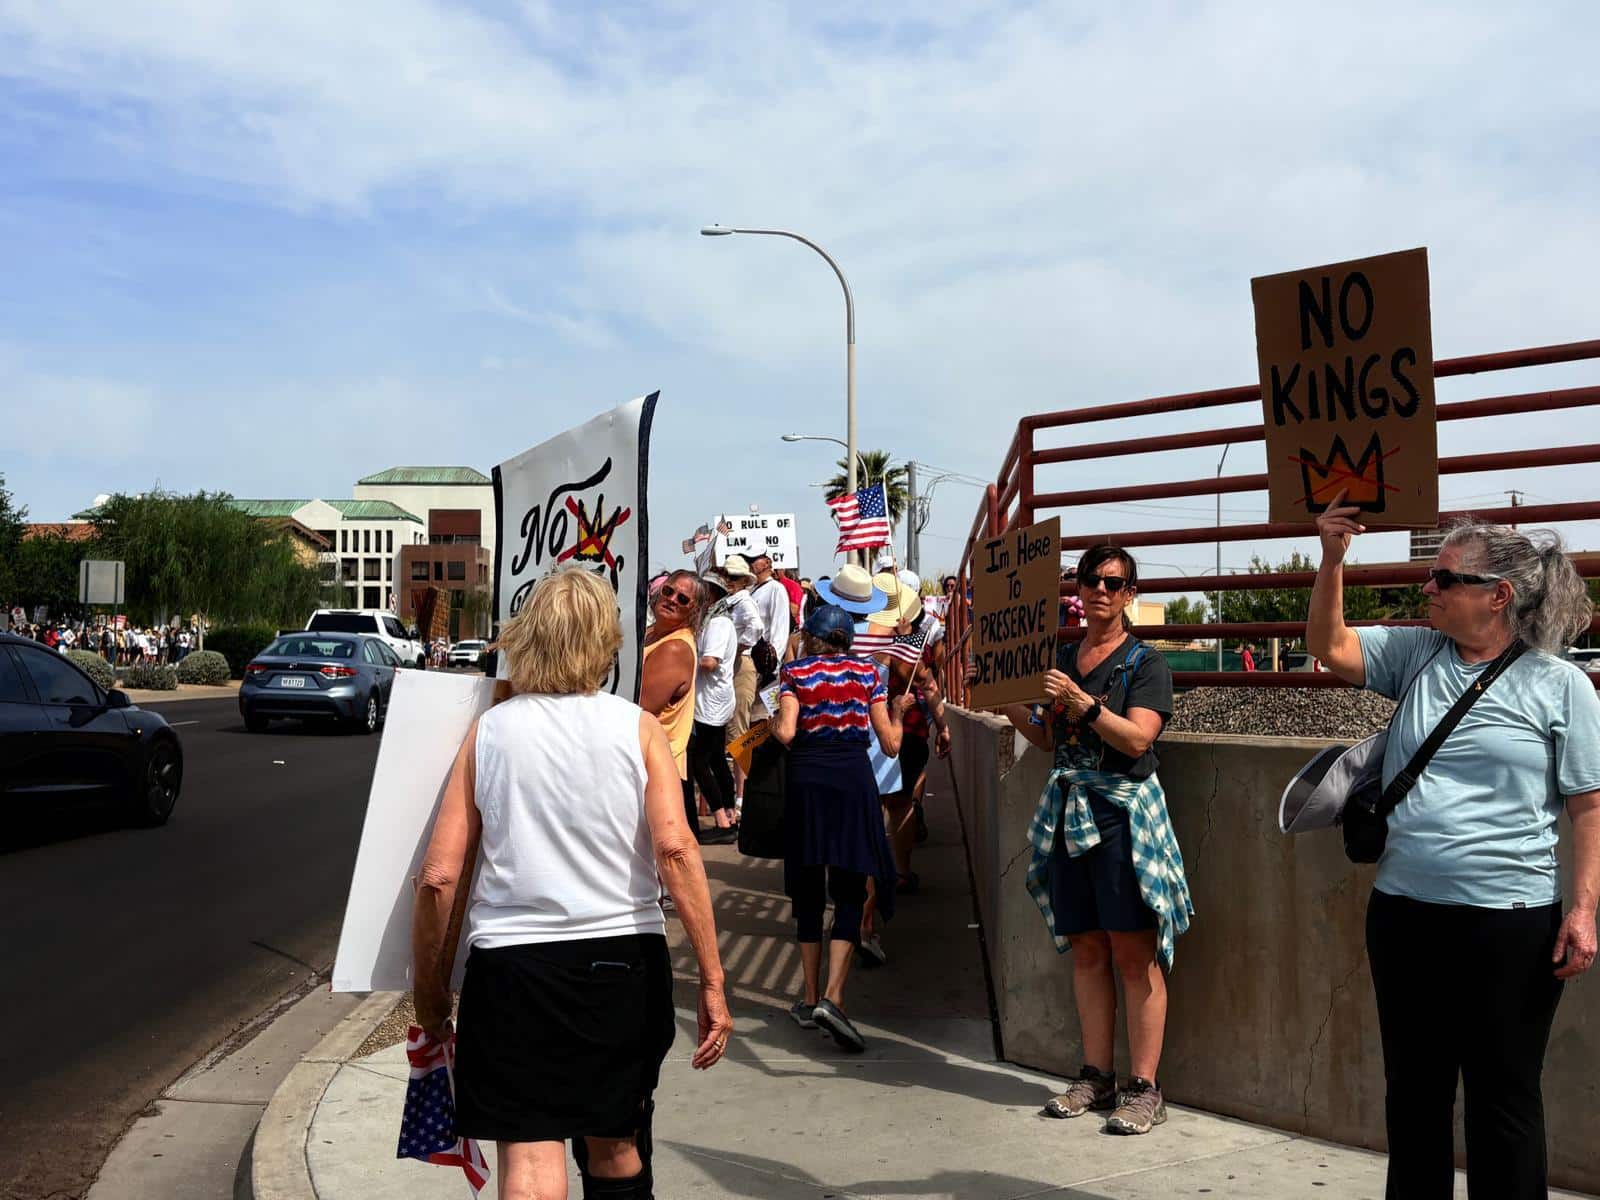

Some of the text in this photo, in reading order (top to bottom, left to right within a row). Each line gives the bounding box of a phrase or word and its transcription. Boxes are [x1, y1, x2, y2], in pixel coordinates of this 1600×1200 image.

[1299, 271, 1374, 350] NO
[1271, 347, 1421, 426] KINGS
[741, 519, 768, 530] RULE
[776, 518, 791, 528] OF
[765, 535, 779, 545] NO
[980, 598, 1046, 645] PRESERVE
[974, 633, 1057, 686] DEMOCRACY
